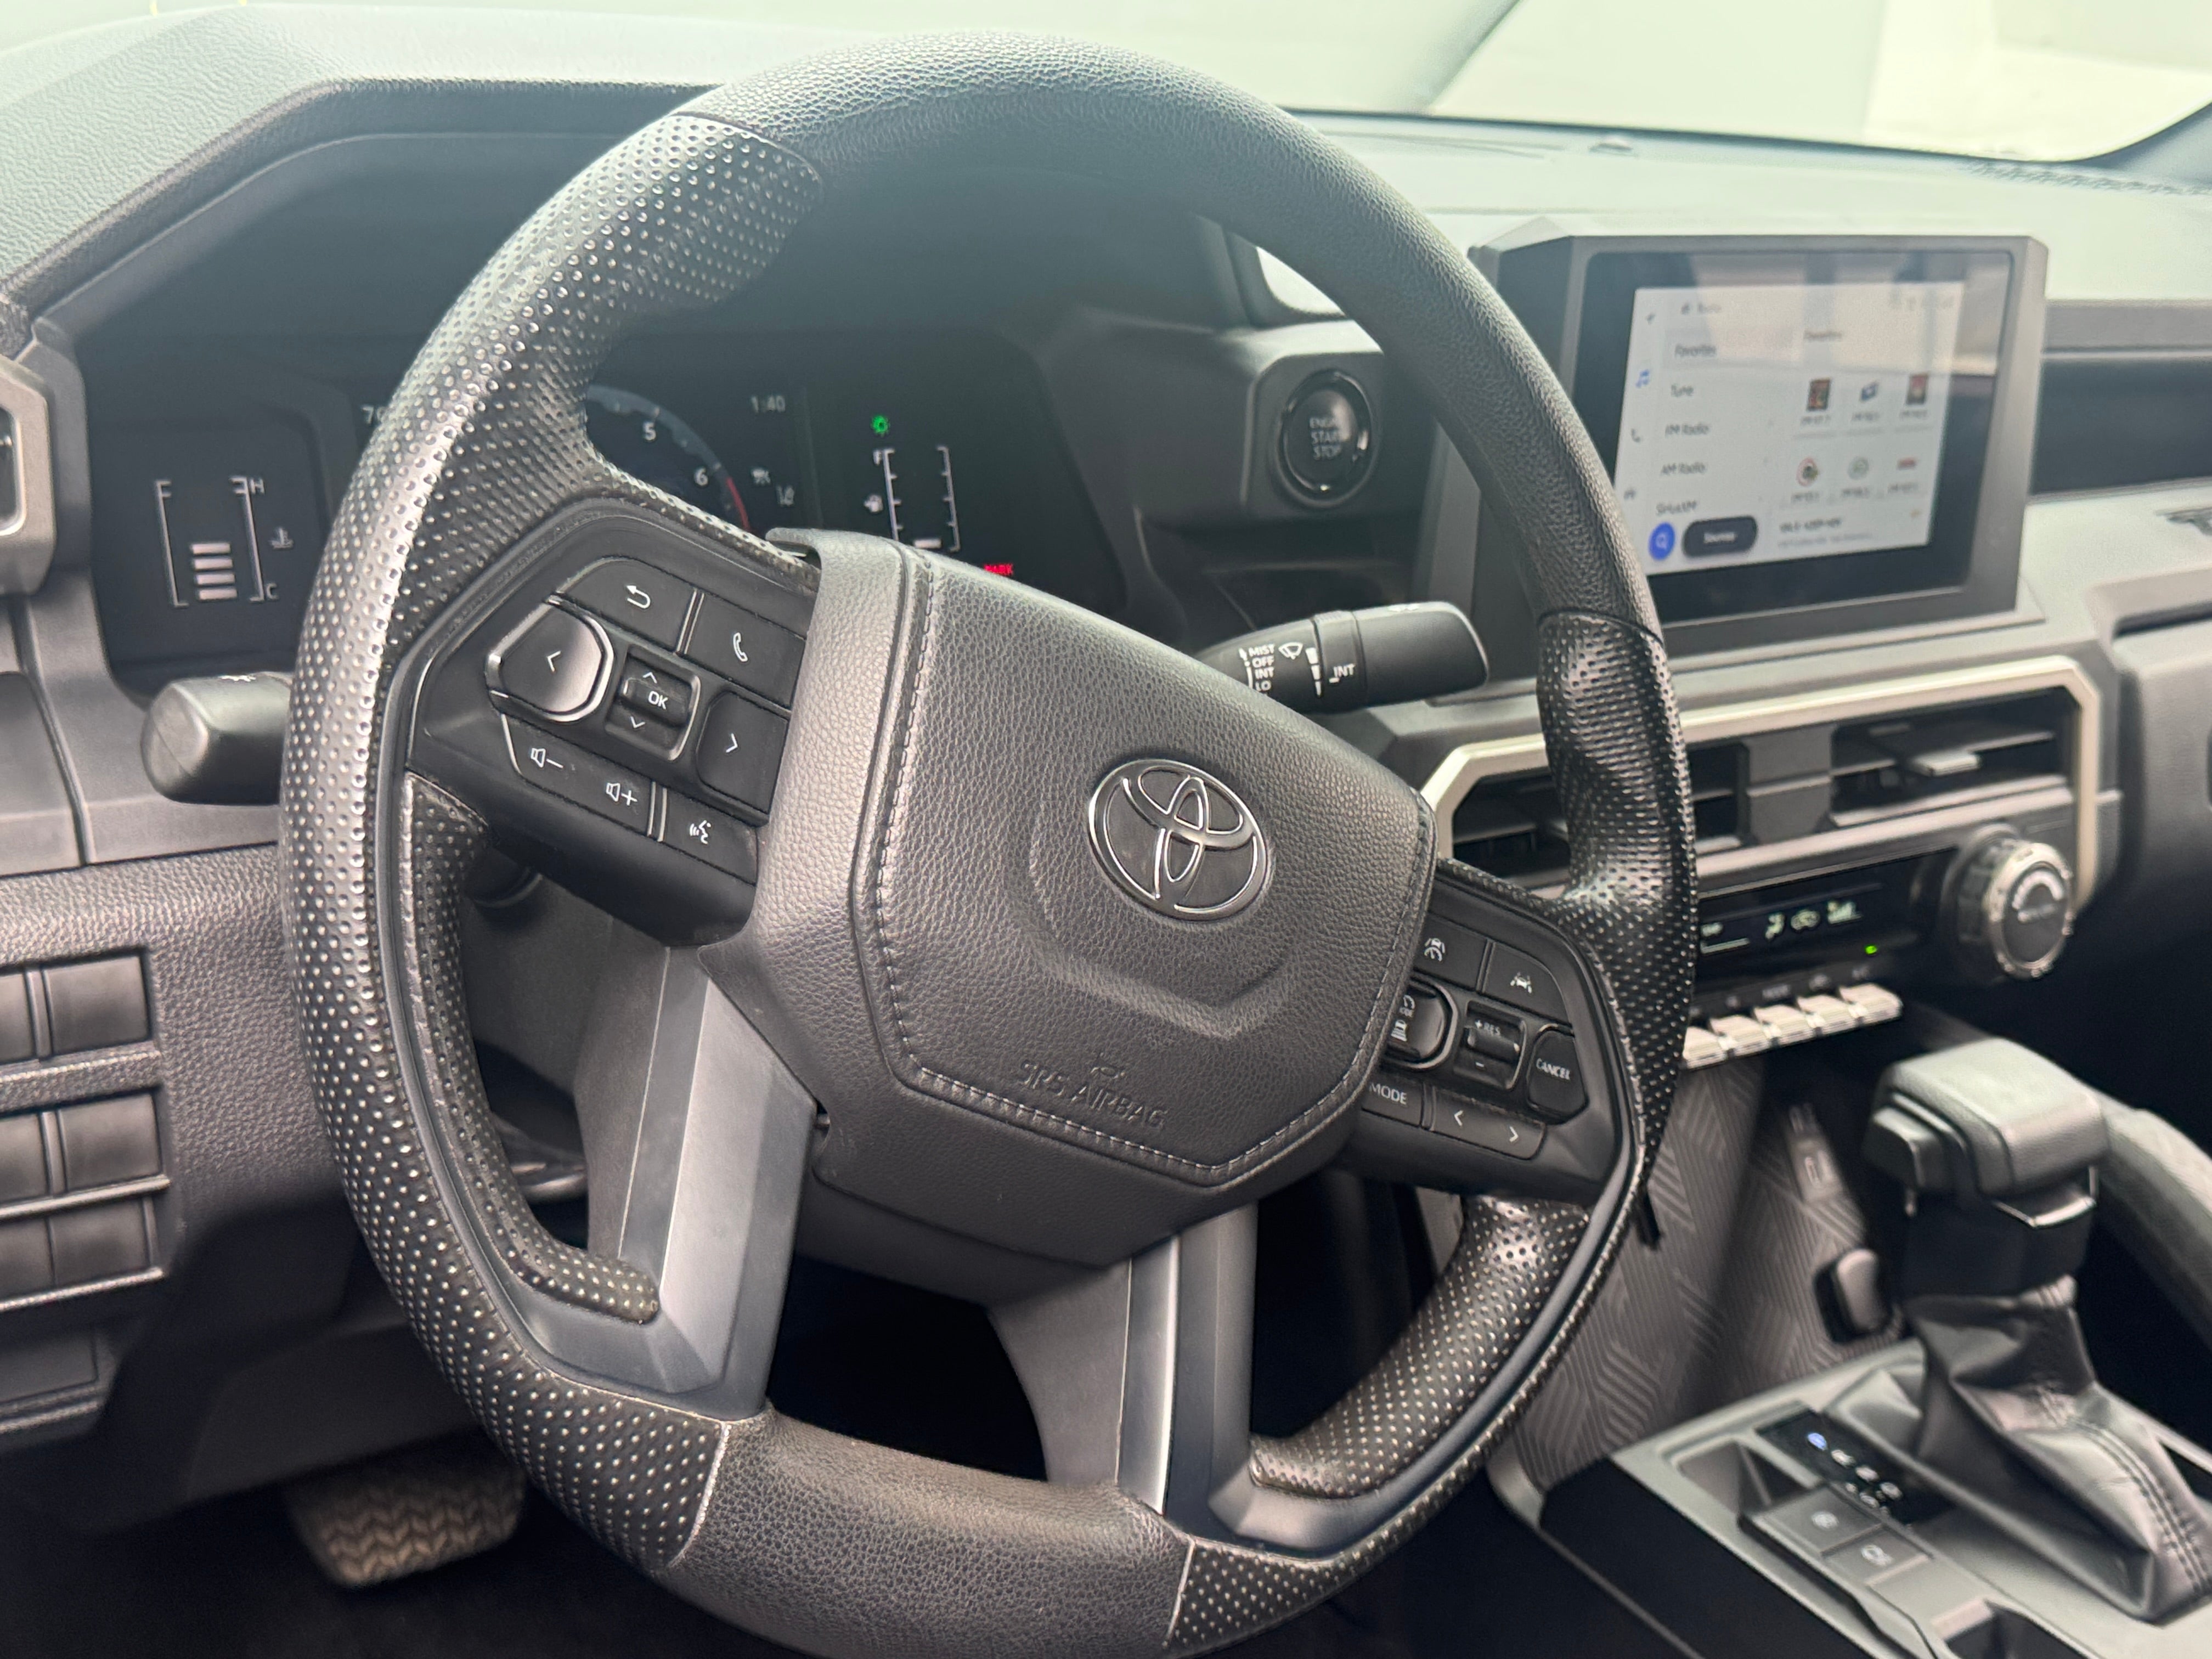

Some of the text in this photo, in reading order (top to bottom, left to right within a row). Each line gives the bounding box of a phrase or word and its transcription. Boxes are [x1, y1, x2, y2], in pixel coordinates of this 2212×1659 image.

[643, 421, 656, 441] 5
[694, 467, 709, 487] 6
[1249, 644, 1275, 657] MIST
[1252, 656, 1274, 668] OFF
[1255, 667, 1274, 679] INT
[1333, 664, 1356, 678] INT
[1255, 680, 1272, 692] LO
[647, 690, 668, 710] OK
[1536, 1057, 1571, 1081] CANCEL
[1369, 1082, 1407, 1105] MODE
